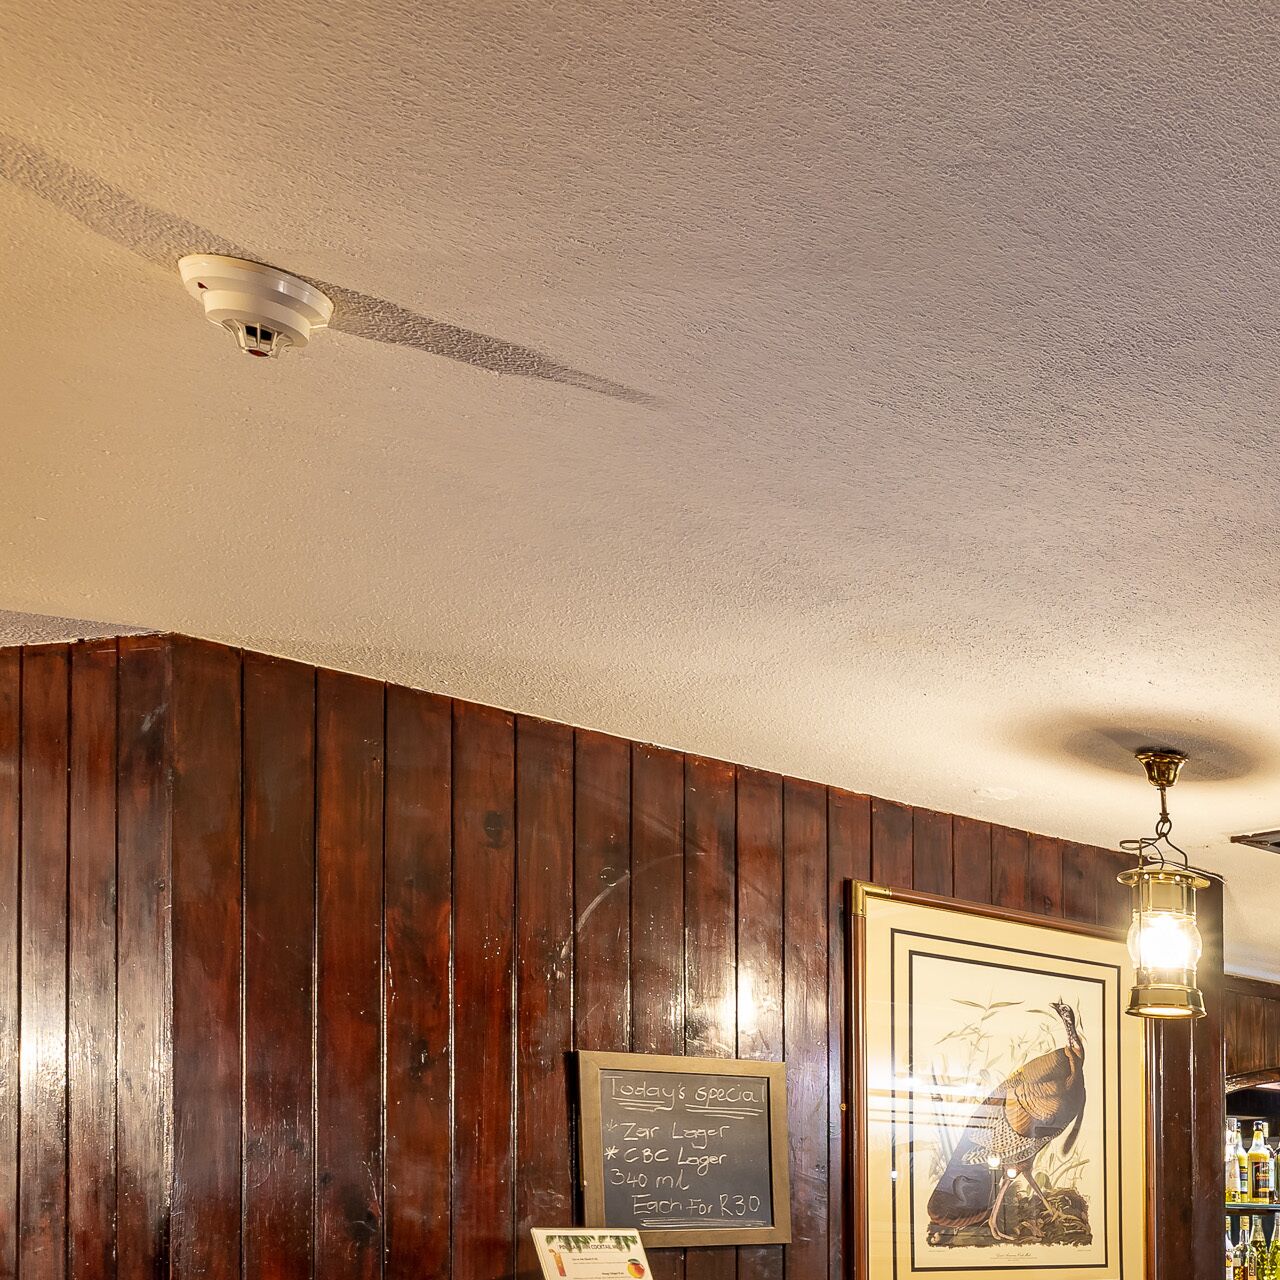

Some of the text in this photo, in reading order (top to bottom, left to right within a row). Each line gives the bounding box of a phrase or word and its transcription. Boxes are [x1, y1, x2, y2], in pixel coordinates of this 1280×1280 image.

[604, 1076, 764, 1110] Today's special
[621, 1122, 730, 1149] Zar Lager
[623, 1147, 728, 1176] CBC Lager
[609, 1168, 690, 1190] 340 ml
[632, 1193, 761, 1216] Each For R30
